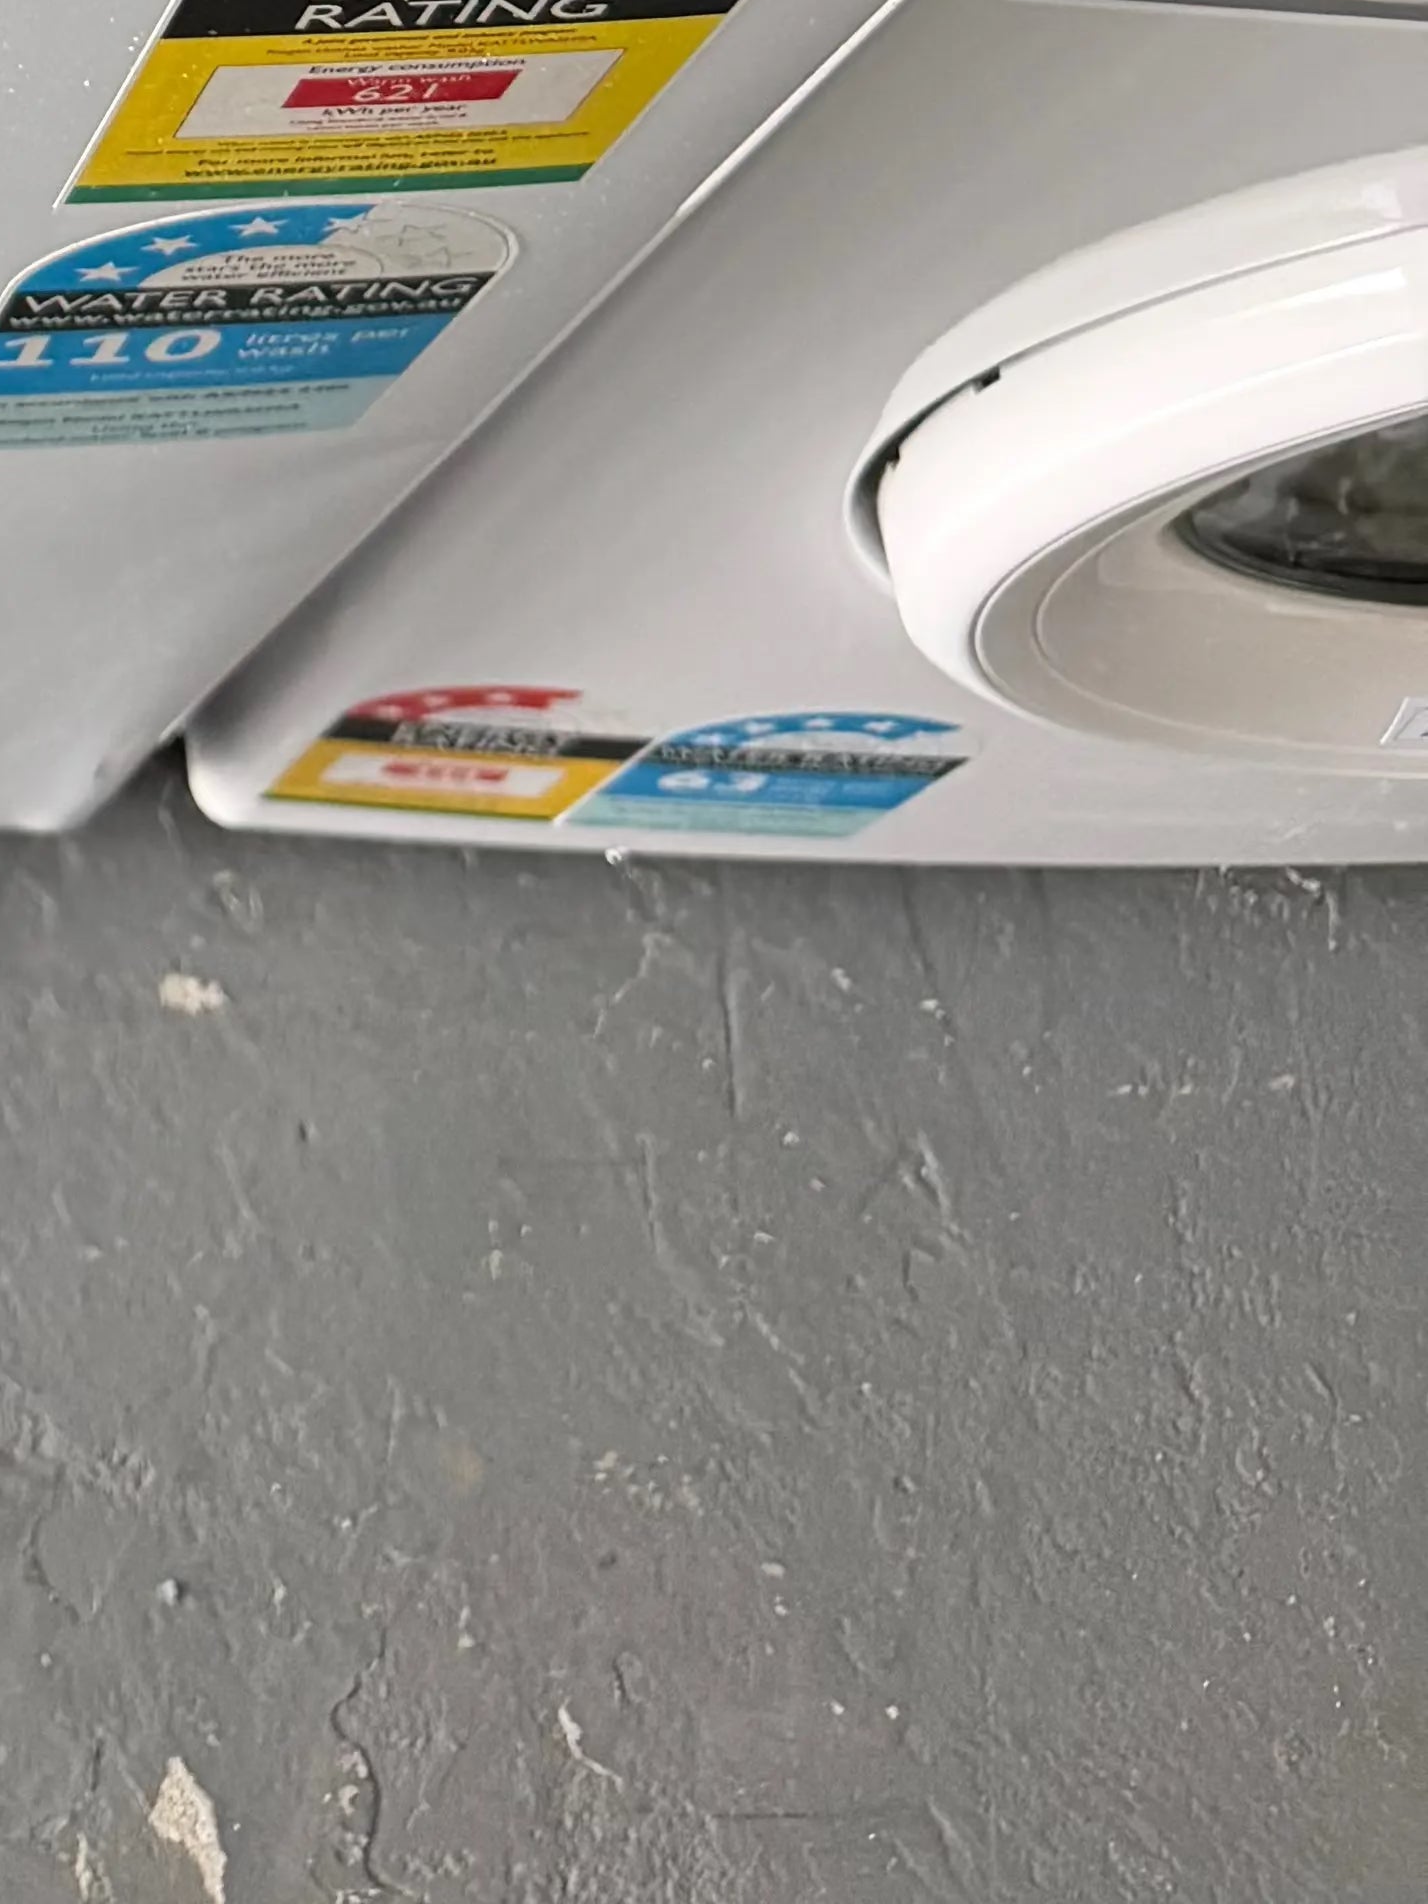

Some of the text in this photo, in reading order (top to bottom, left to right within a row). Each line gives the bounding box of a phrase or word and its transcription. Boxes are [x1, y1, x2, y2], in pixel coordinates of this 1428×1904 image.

[309, 59, 526, 74] Energy consumption
[322, 104, 466, 116] kWh per year
[224, 252, 335, 264] The more
[25, 277, 478, 313] WATER RATING
